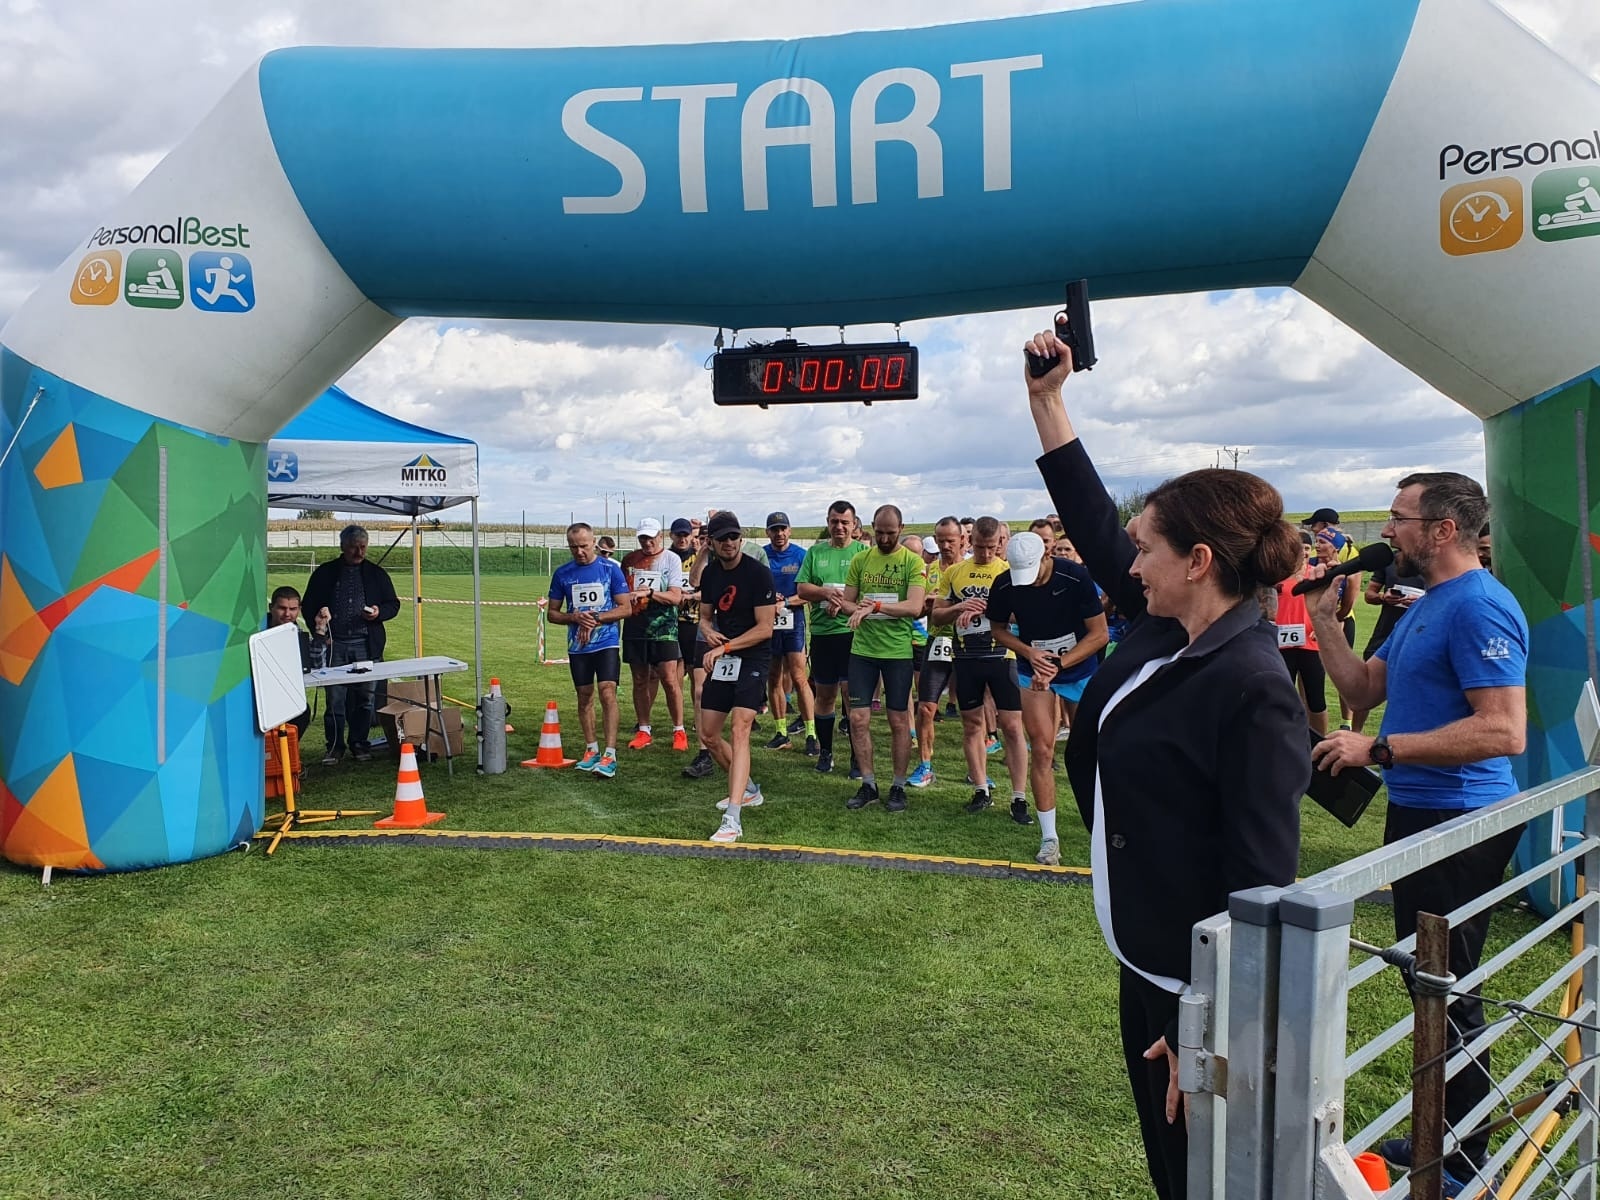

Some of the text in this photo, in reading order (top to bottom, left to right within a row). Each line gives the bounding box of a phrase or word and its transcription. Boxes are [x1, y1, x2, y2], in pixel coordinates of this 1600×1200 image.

[561, 54, 1043, 215] START
[87, 216, 250, 248] PersonalBest
[401, 468, 447, 482] MITKO
[639, 577, 655, 588] 27
[579, 591, 597, 603] 50
[1280, 631, 1299, 643] 76
[933, 645, 952, 657] 59
[721, 663, 734, 676] 12
